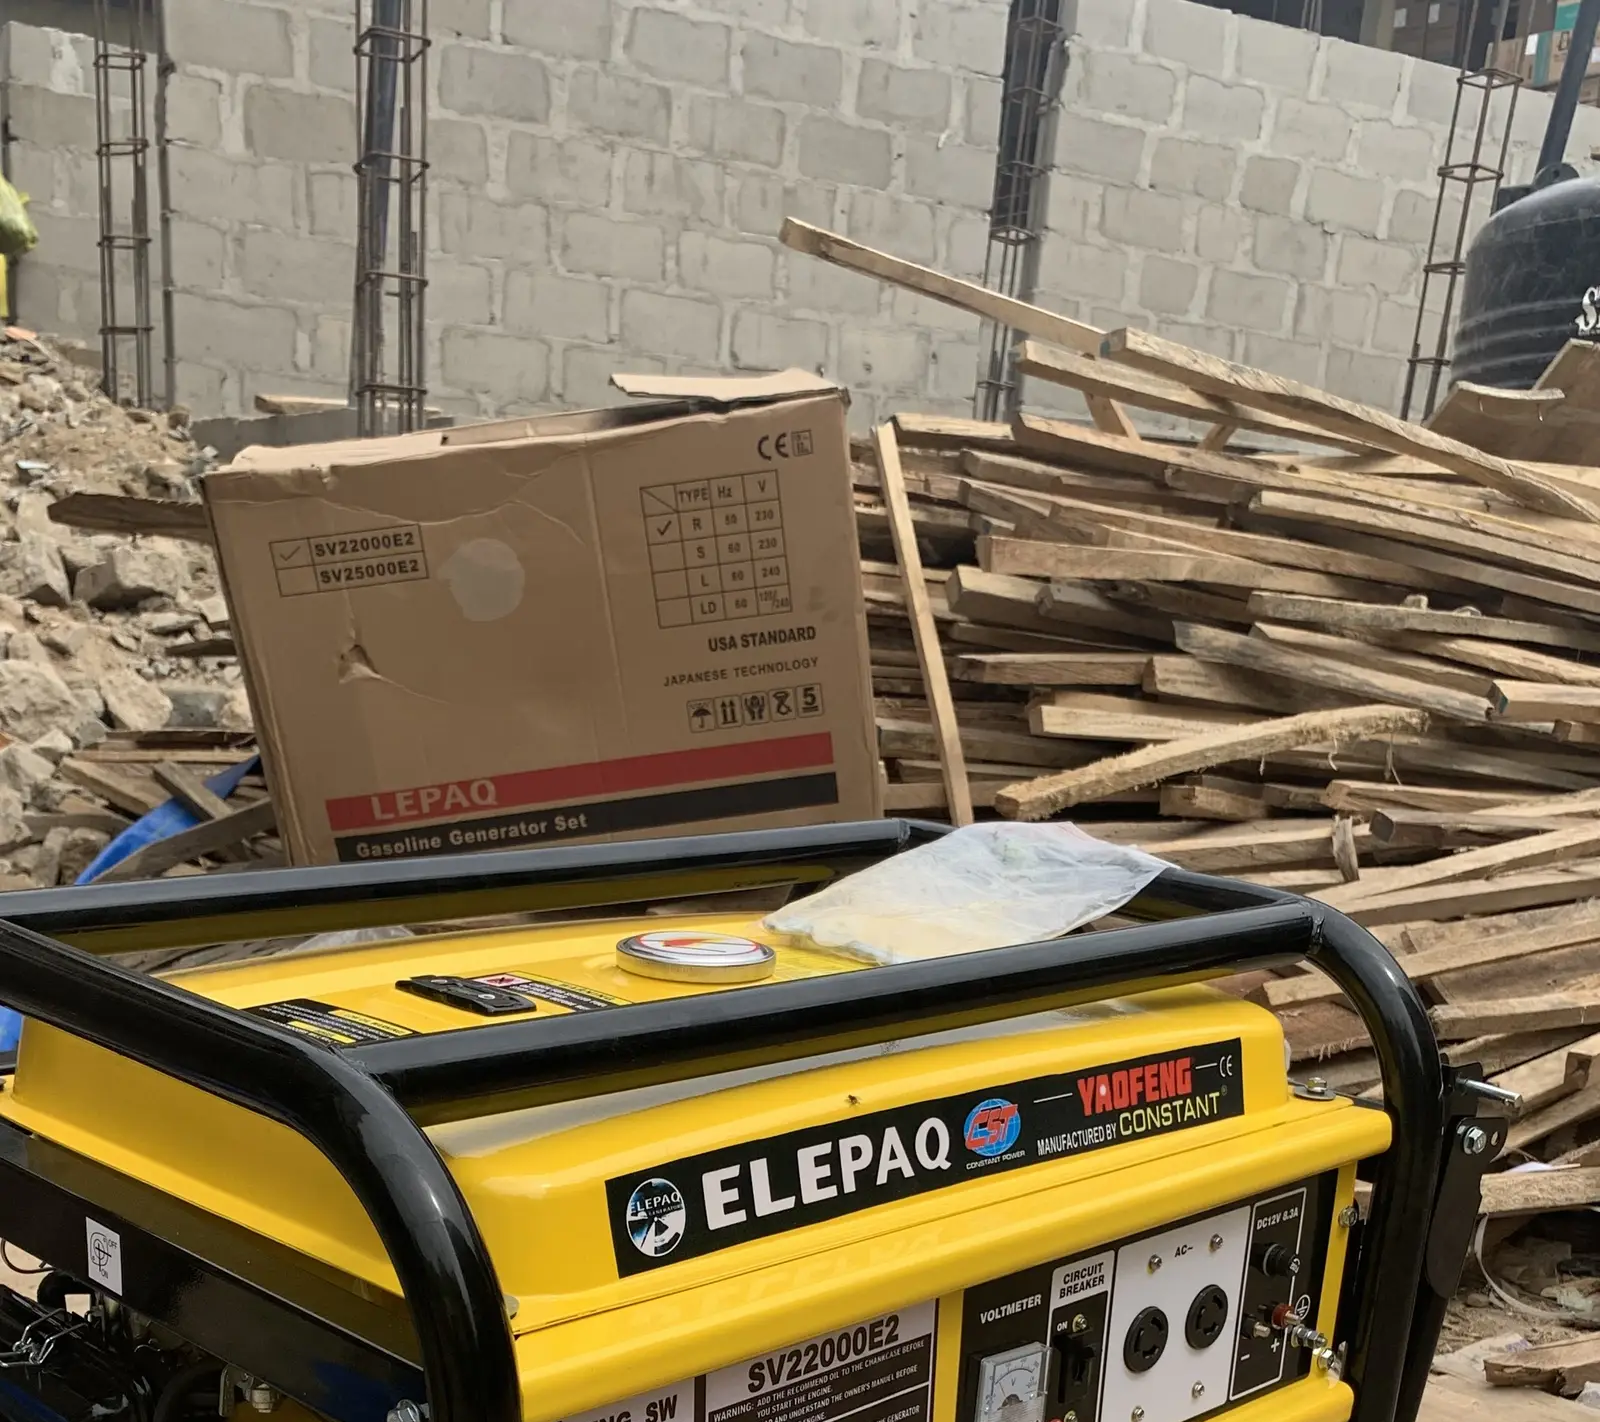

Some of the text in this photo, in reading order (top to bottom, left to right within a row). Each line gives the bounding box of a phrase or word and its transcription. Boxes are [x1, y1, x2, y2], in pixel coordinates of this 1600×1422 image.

[757, 432, 789, 461] CE
[679, 488, 708, 503] TYPE
[718, 485, 732, 499] Hz
[758, 480, 766, 492] V
[693, 518, 702, 530] R
[755, 509, 773, 521] 230
[314, 532, 415, 557] SV22000E2
[697, 546, 705, 559] S
[758, 538, 777, 550] 230
[320, 559, 420, 584] SV25000E2
[701, 575, 709, 587] L
[700, 602, 716, 615] LD
[708, 626, 816, 652] USA STANDARD
[663, 657, 819, 687] JAPANESE TECHNOLOGY
[370, 778, 497, 821] LEPAQ
[356, 813, 588, 859] Gasoline Generator Set
[1077, 1055, 1233, 1117] YAOFENG CE
[1037, 1091, 1220, 1156] MANUFACTURED BY CONSTANT
[966, 1149, 1026, 1170] CONSTANT POWER
[702, 1117, 952, 1231] ELEPAQ
[630, 1191, 681, 1213] ELEPAQ
[1257, 1207, 1299, 1230] DC12V 8.3A
[1063, 1262, 1104, 1285] CIRCUIT
[1059, 1274, 1105, 1299] BREAKER
[980, 1294, 1042, 1324] VOLTMETER
[1057, 1321, 1068, 1332] ON
[748, 1314, 899, 1393] SV22000E2
[757, 1395, 771, 1407] ADD
[772, 1391, 786, 1403] THE
[787, 1376, 828, 1396] RECOMMEND
[829, 1371, 840, 1381] OIL
[841, 1367, 850, 1376] TO
[851, 1361, 864, 1373] THE
[902, 1339, 925, 1355] BEFORE
[757, 1385, 833, 1419] YOU START THE ENGINE.
[789, 1398, 830, 1422] UNDERSTAND
[831, 1393, 843, 1404] THE
[844, 1382, 871, 1400] OWNER'S
[896, 1364, 918, 1379] BEFORE
